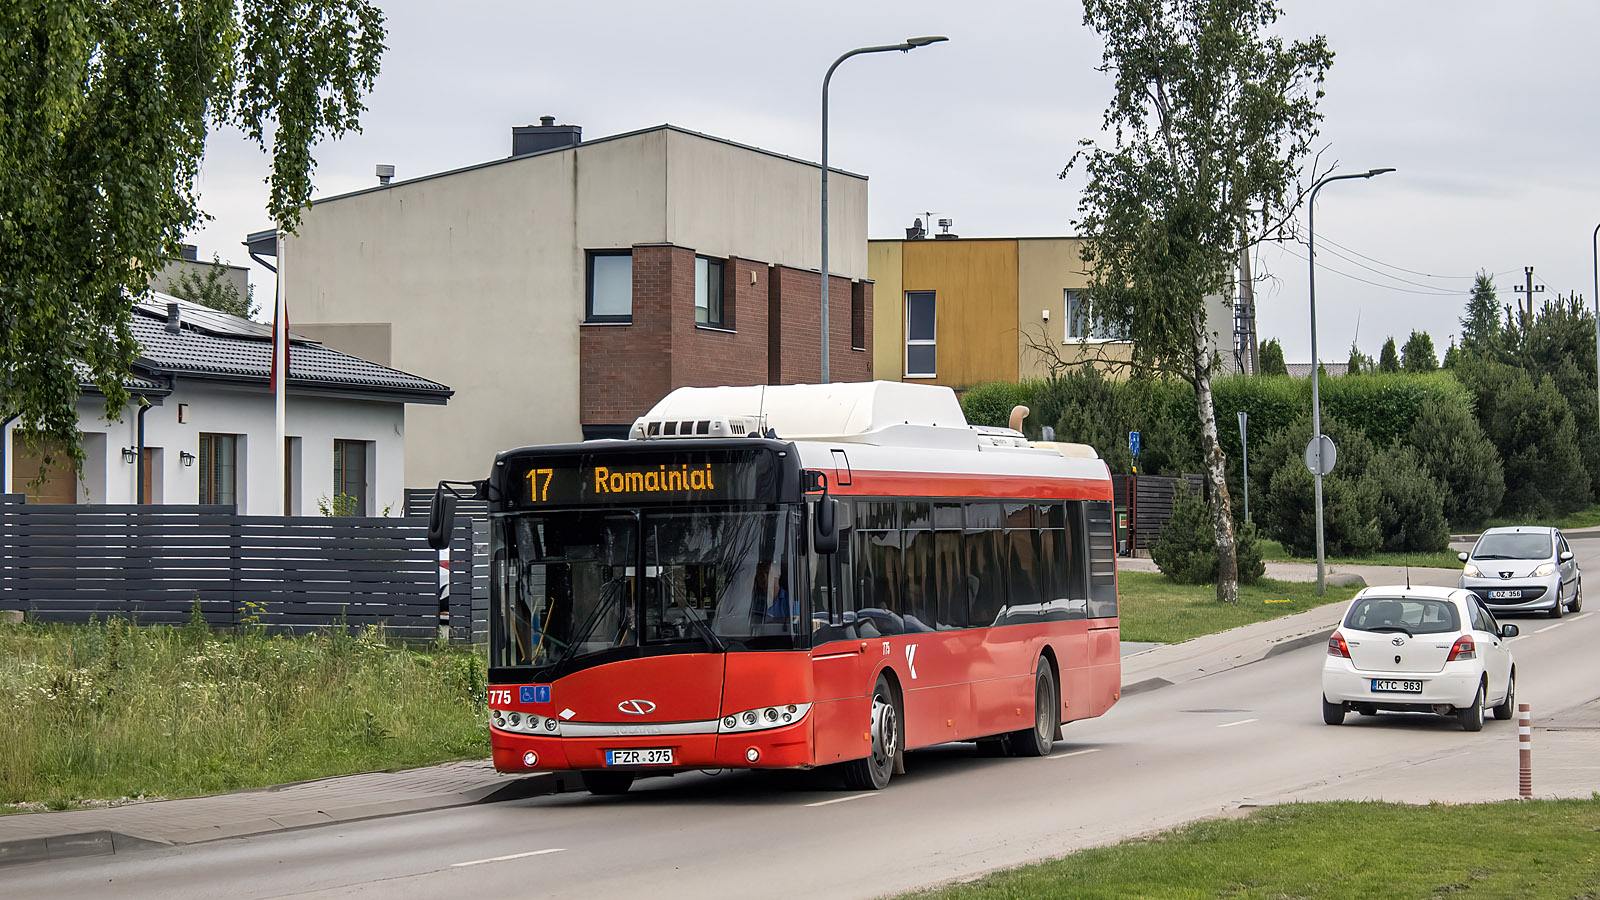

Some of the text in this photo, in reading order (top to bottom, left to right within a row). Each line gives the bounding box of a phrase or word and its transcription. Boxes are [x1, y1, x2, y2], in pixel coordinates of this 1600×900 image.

[525, 463, 714, 502] 17 Romainiai
[1377, 680, 1421, 691] KTC 963
[490, 690, 511, 704] 775
[614, 751, 640, 763] FZR
[648, 750, 671, 762] 375
